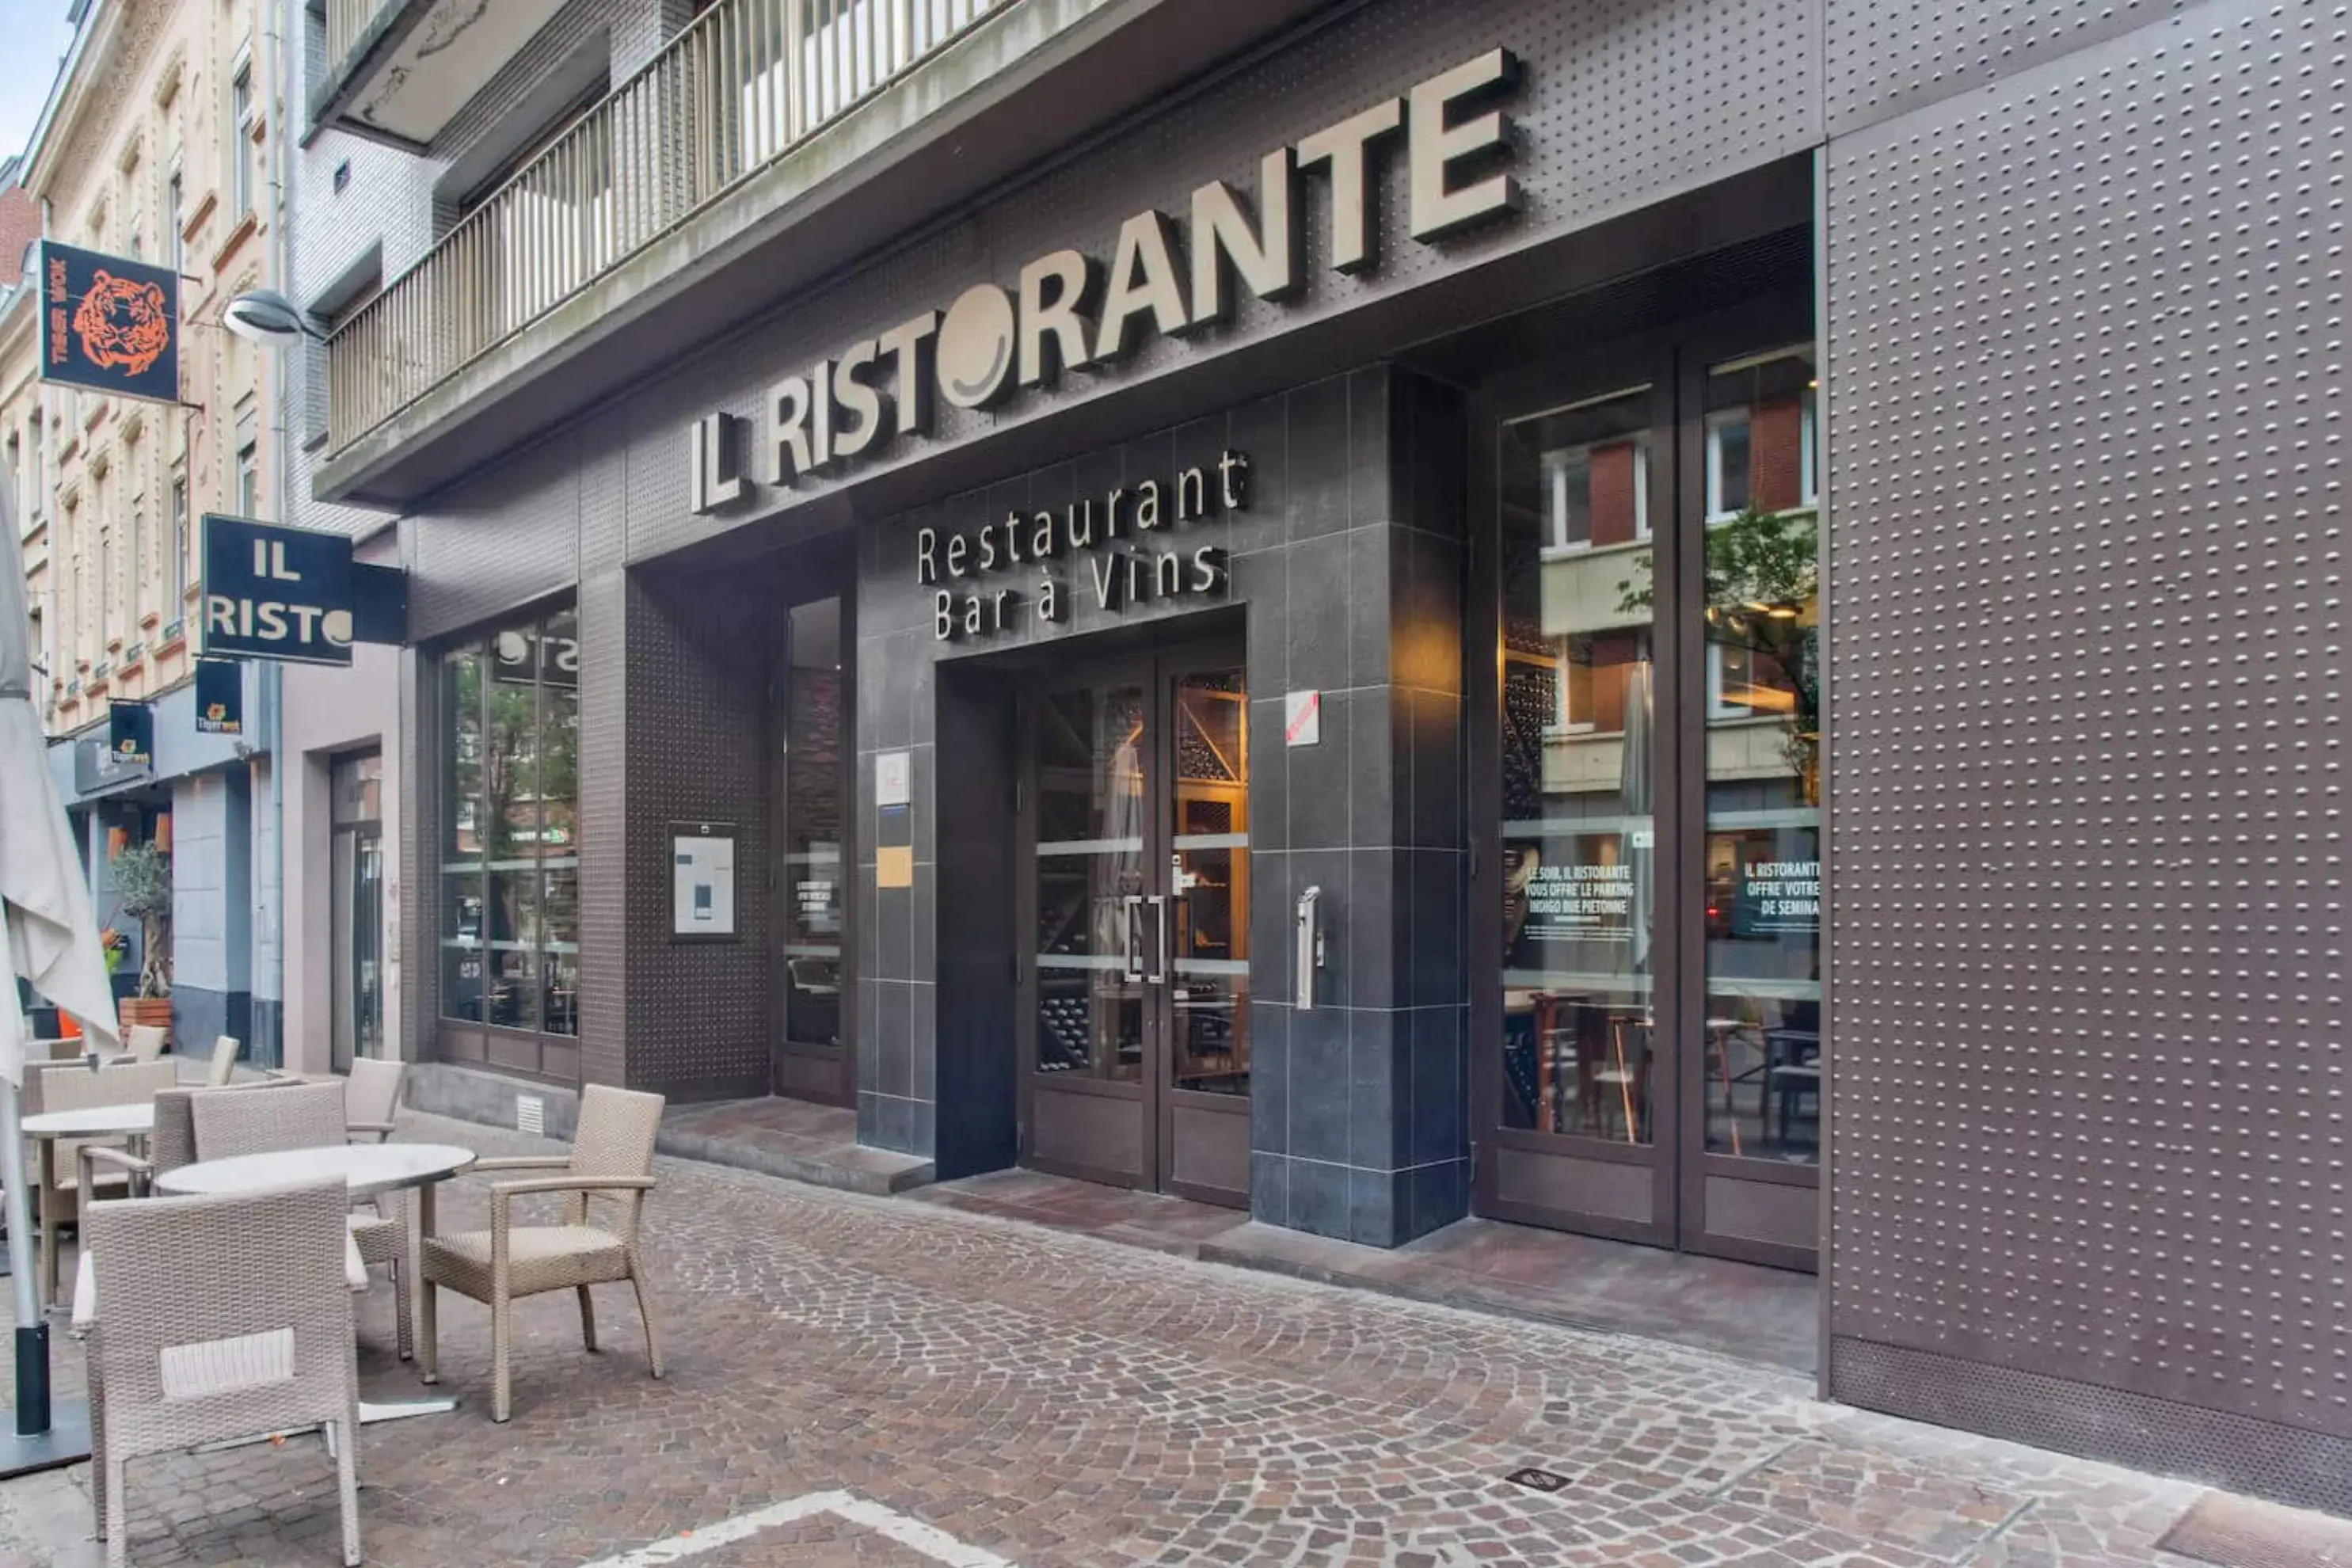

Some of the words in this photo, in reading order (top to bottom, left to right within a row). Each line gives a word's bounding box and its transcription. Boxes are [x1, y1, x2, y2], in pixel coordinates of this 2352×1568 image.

[691, 411, 741, 515] IL
[766, 44, 1514, 486] RISTORANTE
[253, 539, 302, 581] IL
[917, 450, 1248, 584] Restaurant
[207, 594, 352, 647] RISTO
[934, 588, 1010, 641] Bar
[1037, 563, 1056, 621] à
[1090, 544, 1221, 611] Vins
